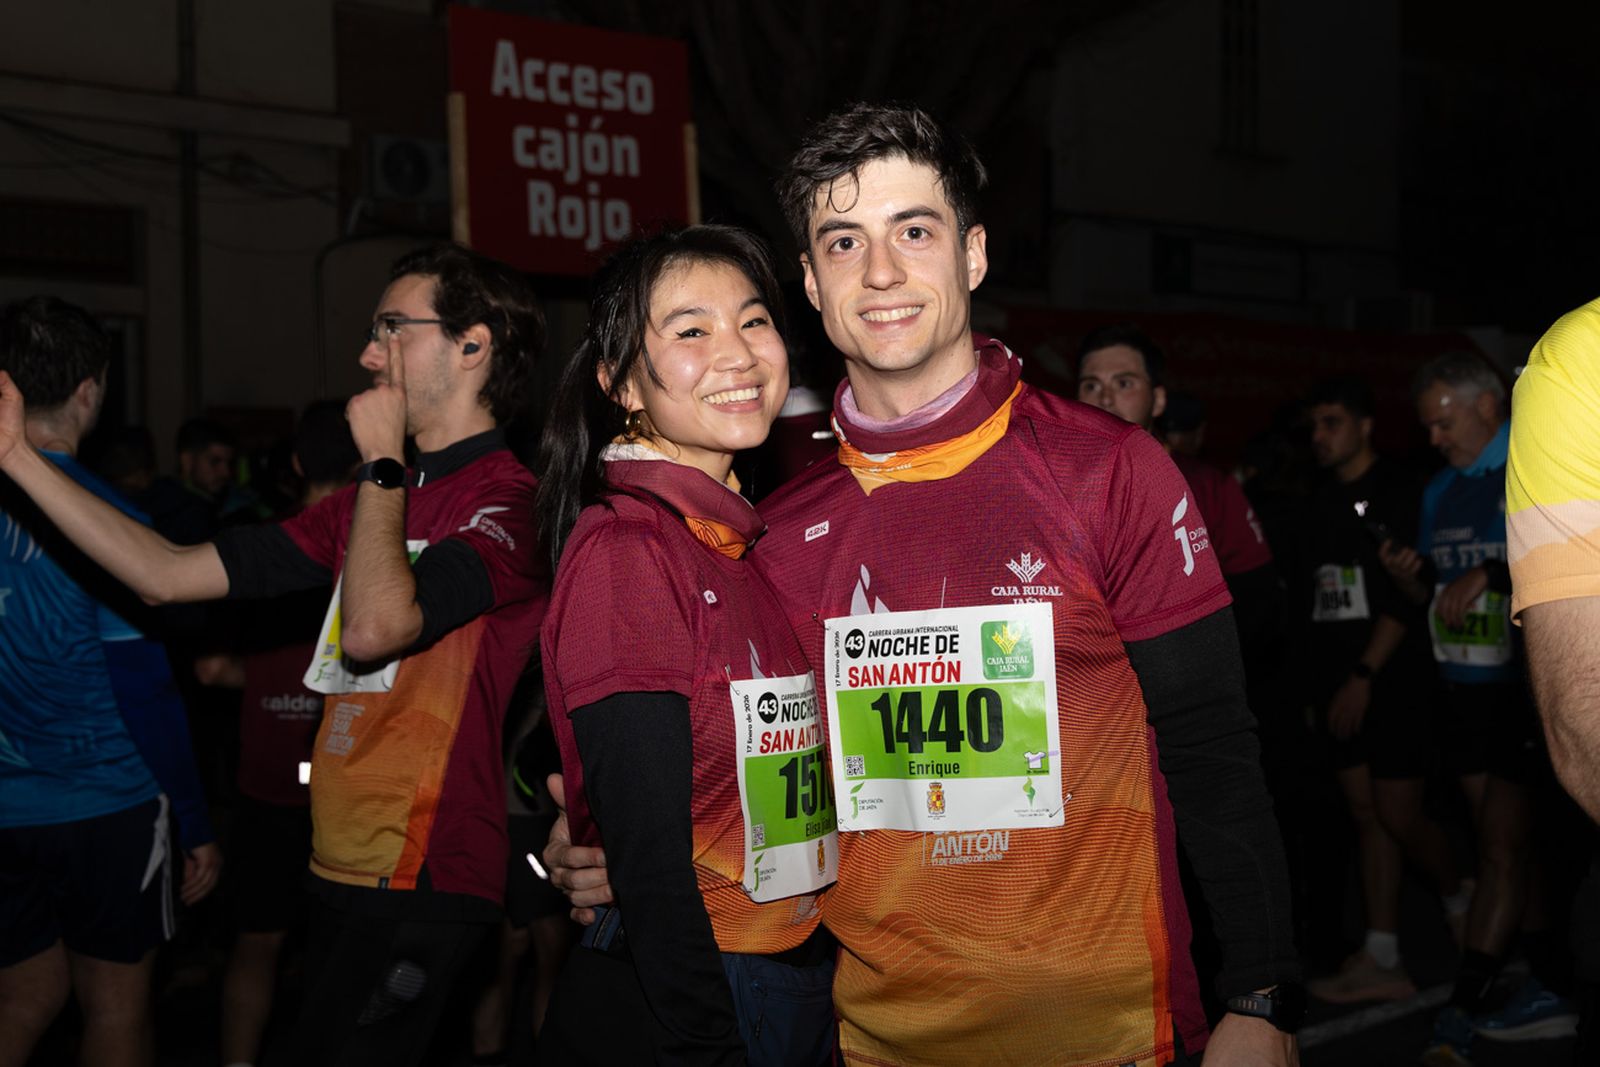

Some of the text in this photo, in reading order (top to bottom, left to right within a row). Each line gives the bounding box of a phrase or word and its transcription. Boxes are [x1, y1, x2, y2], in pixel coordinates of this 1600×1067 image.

[490, 39, 654, 115] Acceso
[512, 114, 640, 185] cajón
[527, 179, 631, 250] Rojo
[991, 585, 1063, 597] CAJA RURAL
[868, 624, 959, 638] CARRERA URBANA INTERNACIONAL
[845, 635, 864, 651] 43
[868, 633, 960, 658] NOCHE DE
[986, 655, 1030, 666] CAJA RURAL
[999, 663, 1018, 673] JAÉN
[848, 655, 961, 688] SAN ANTÓN
[743, 694, 751, 712] 2026
[759, 699, 778, 715] 43
[745, 713, 753, 723] de
[870, 687, 1004, 754] 1440
[746, 745, 753, 753] 17
[759, 729, 795, 754] SAN
[908, 760, 960, 777] Enrique
[779, 749, 834, 819] 157
[931, 828, 1009, 859] ANTÓN
